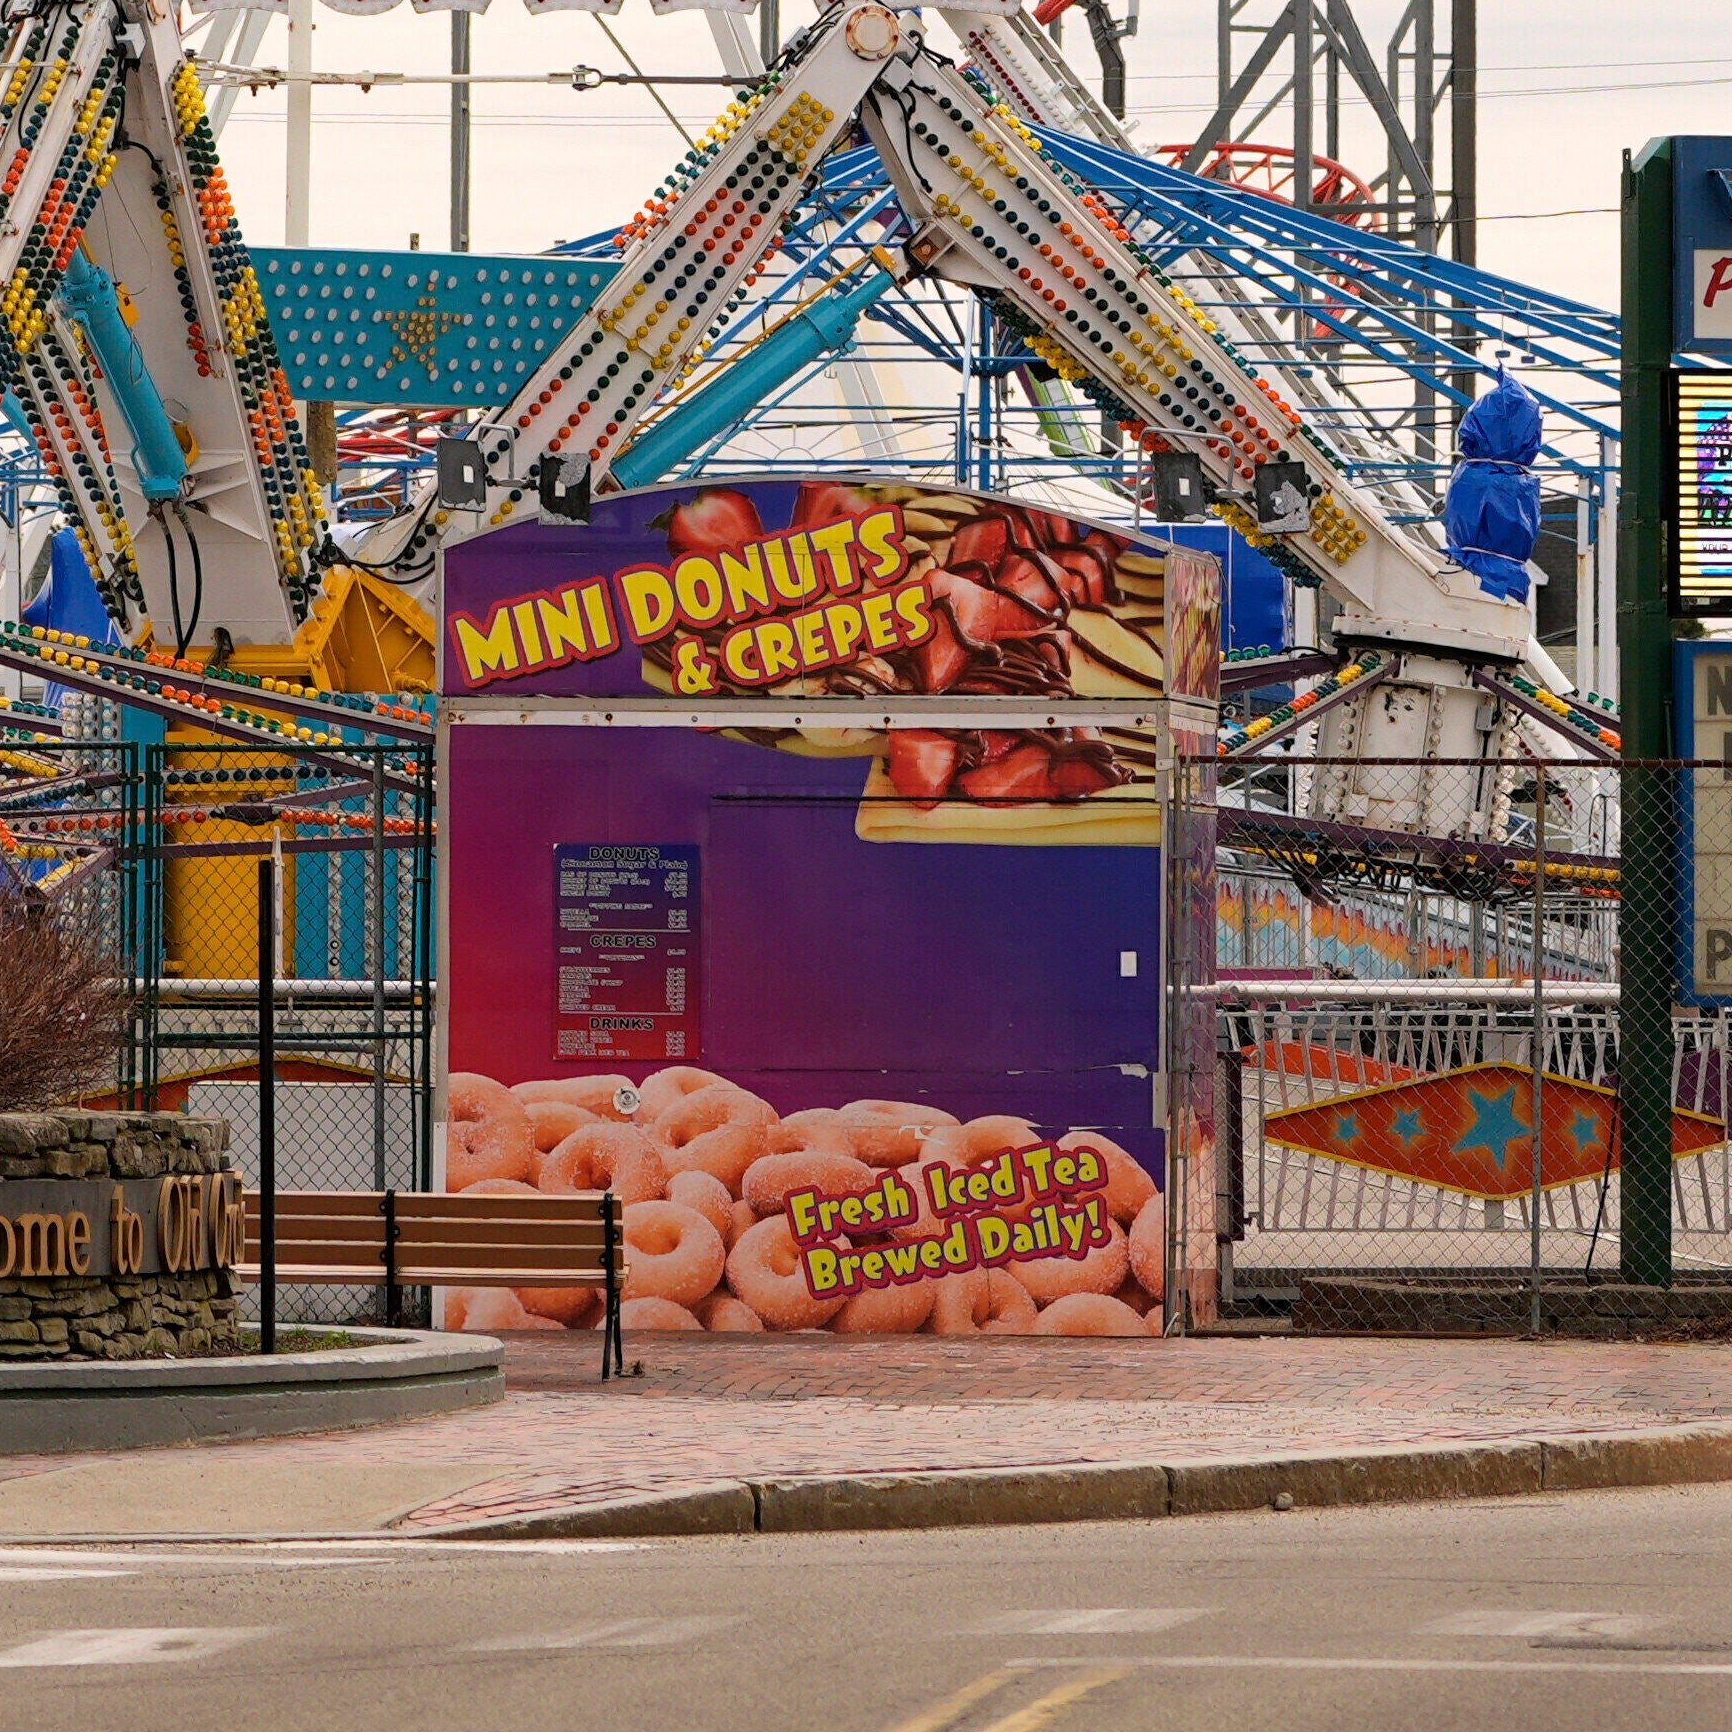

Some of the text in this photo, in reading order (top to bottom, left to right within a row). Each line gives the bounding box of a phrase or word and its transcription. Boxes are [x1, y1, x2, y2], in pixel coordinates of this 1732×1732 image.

[449, 505, 908, 686] MINI DONUTS
[676, 583, 934, 695] & CREPES
[589, 847, 660, 860] DONUTS
[589, 935, 657, 948] CREPES
[589, 1017, 655, 1030] DRINKS
[110, 1184, 144, 1275] to
[157, 1175, 204, 1273] Old
[789, 1145, 1104, 1238] Fresh Iced Tea
[806, 1200, 1104, 1297] Brewed Daily!
